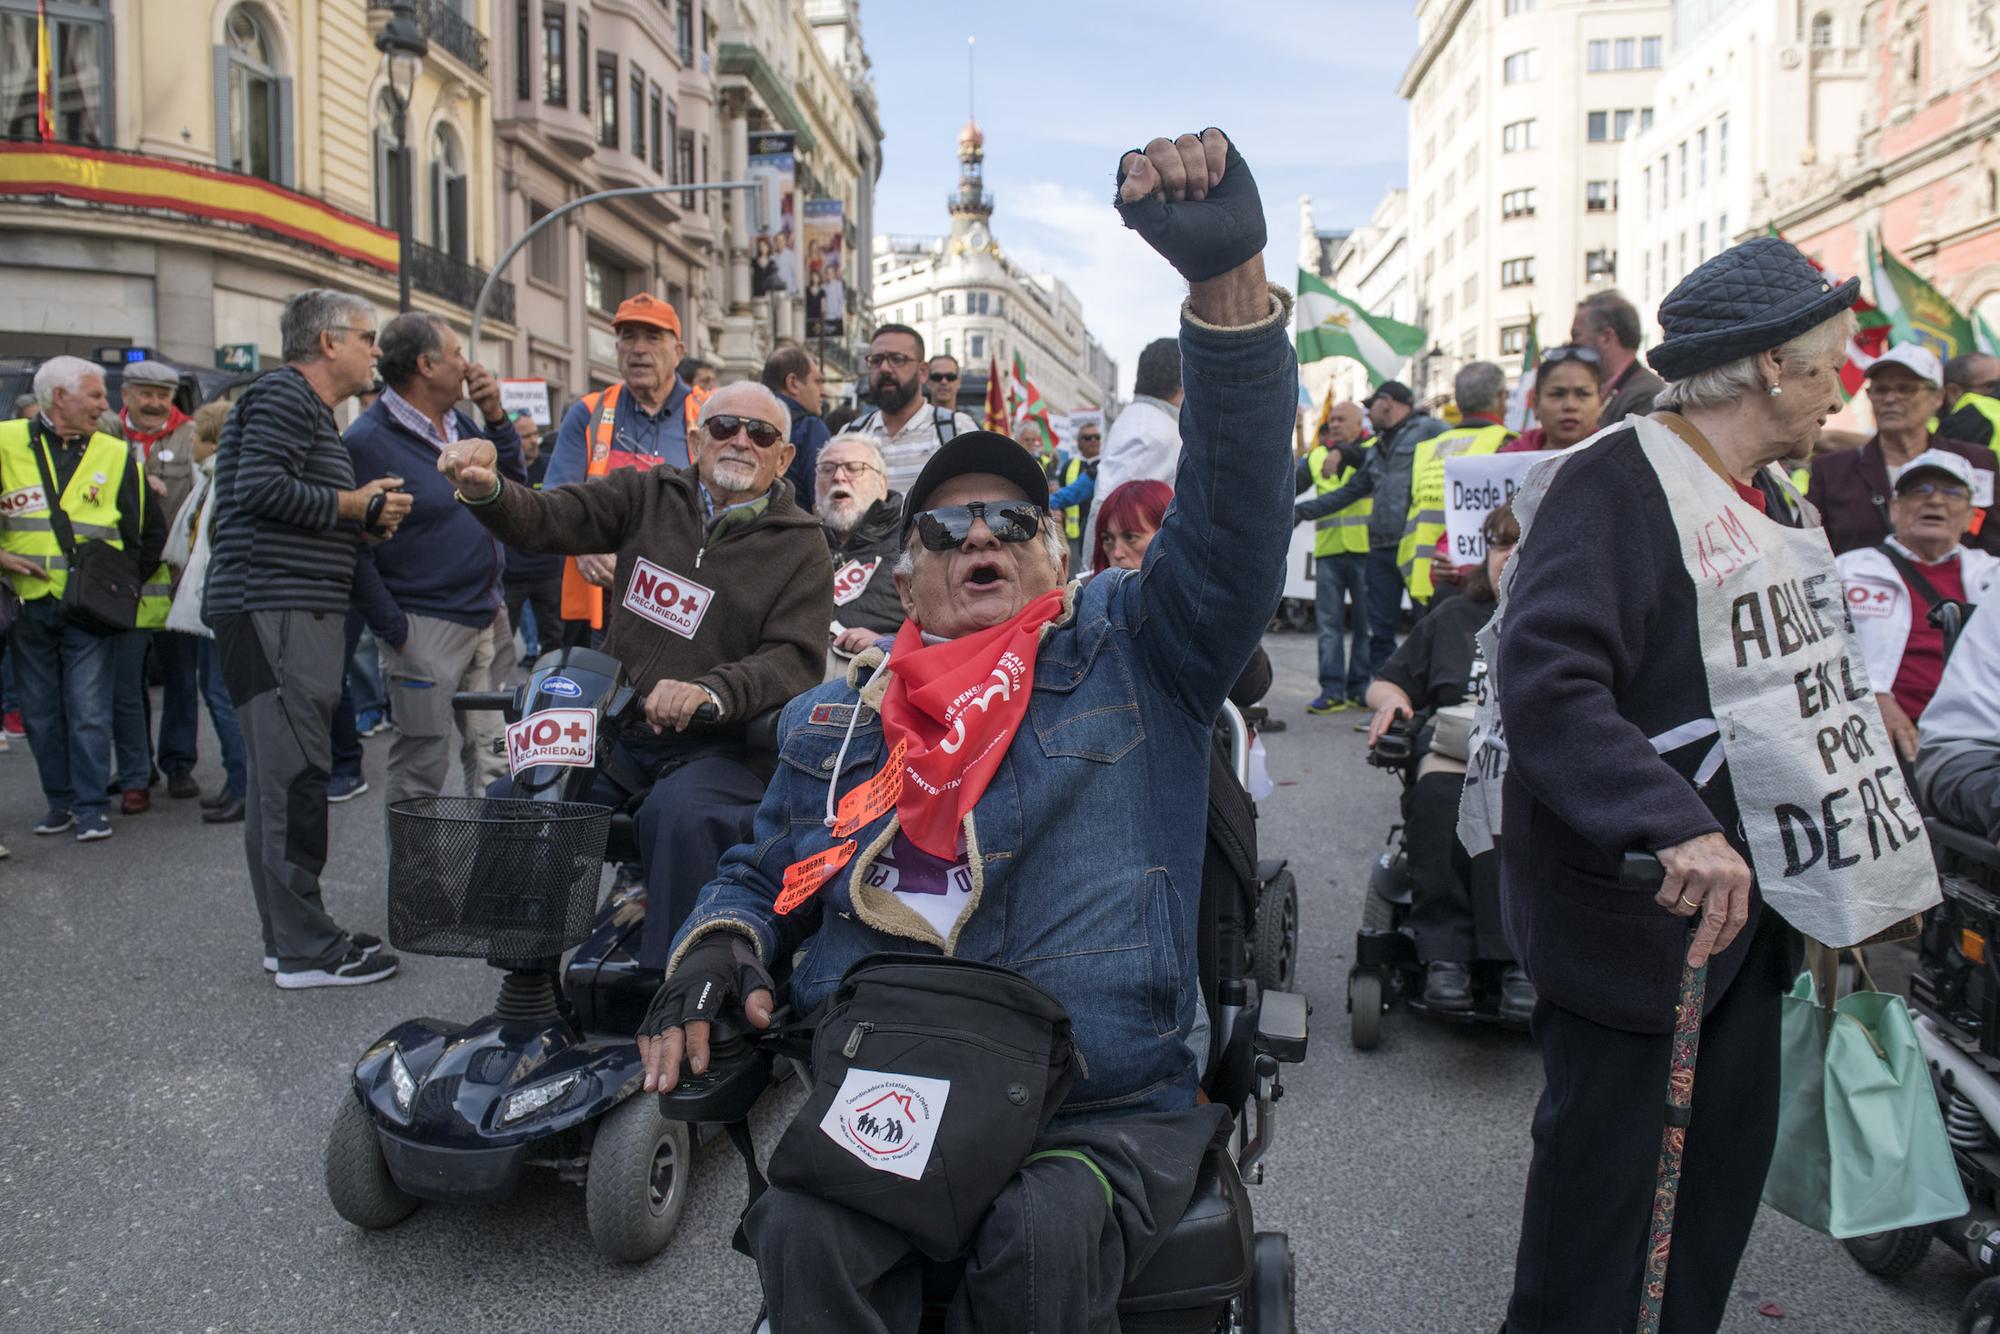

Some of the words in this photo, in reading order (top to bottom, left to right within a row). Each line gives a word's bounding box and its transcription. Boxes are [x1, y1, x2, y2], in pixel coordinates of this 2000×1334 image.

[1453, 479, 1500, 510] Desde
[630, 593, 692, 628] PRECARIEDAD
[1841, 656, 1869, 701] L
[1817, 714, 1874, 775] POR
[1774, 766, 1920, 878] DERE
[846, 1083, 884, 1105] Coordinadora
[885, 1081, 906, 1090] Estatal
[905, 1086, 916, 1094] por
[915, 1091, 921, 1099] la
[918, 1097, 930, 1120] Defensa
